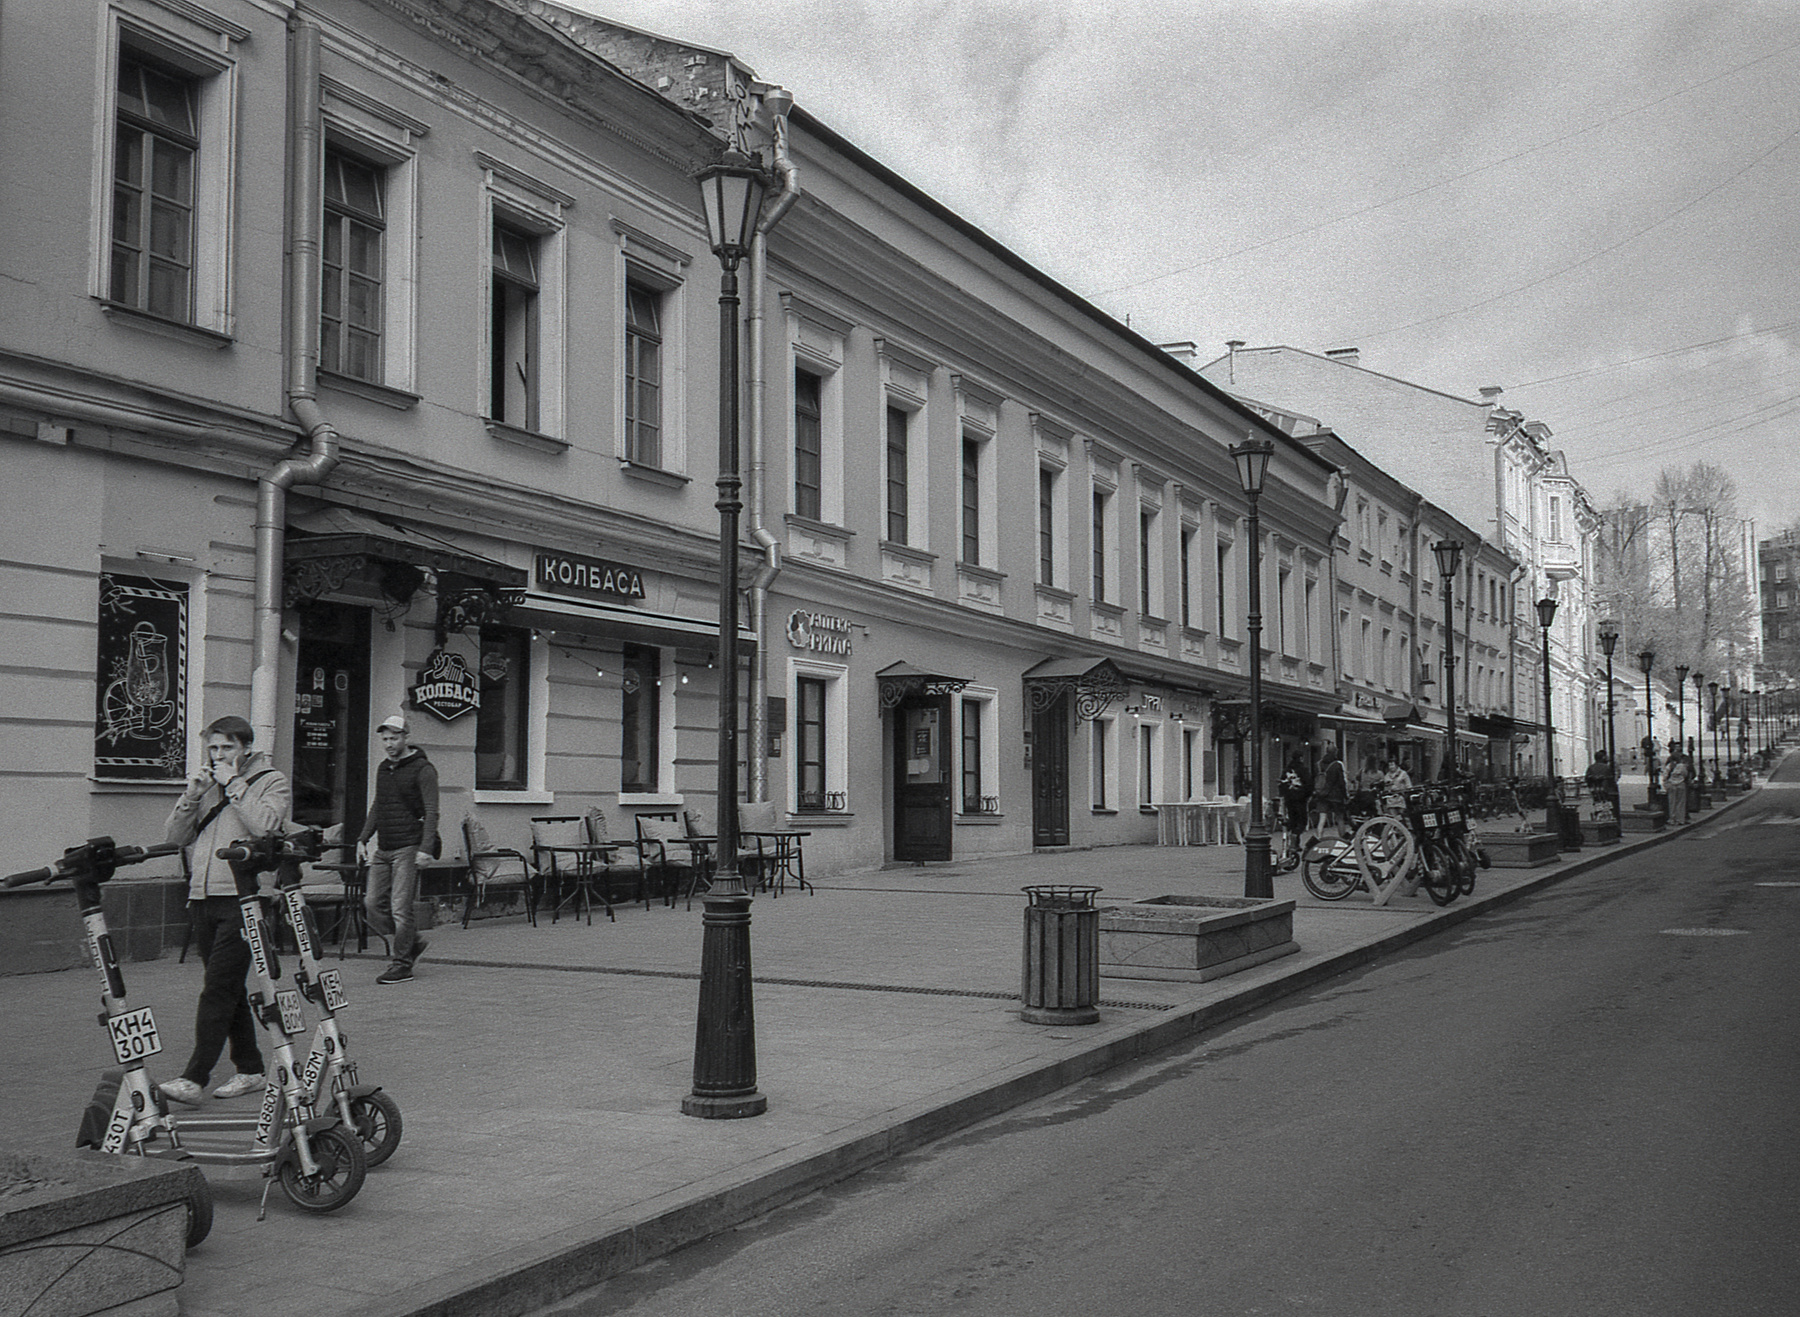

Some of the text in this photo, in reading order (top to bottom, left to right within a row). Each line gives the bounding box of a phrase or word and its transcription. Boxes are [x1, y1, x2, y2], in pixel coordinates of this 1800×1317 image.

[545, 558, 641, 597] КОЛБАСА
[415, 682, 480, 708] КОЛБАСА
[288, 892, 311, 953] WHOOSH
[244, 906, 266, 974] WHOOSH
[321, 973, 341, 991] KE4
[327, 990, 346, 1007] 87M
[111, 1012, 153, 1039] KH4
[117, 1031, 156, 1058] 30T
[303, 1051, 324, 1090] 487M
[256, 1082, 279, 1144] KA880M
